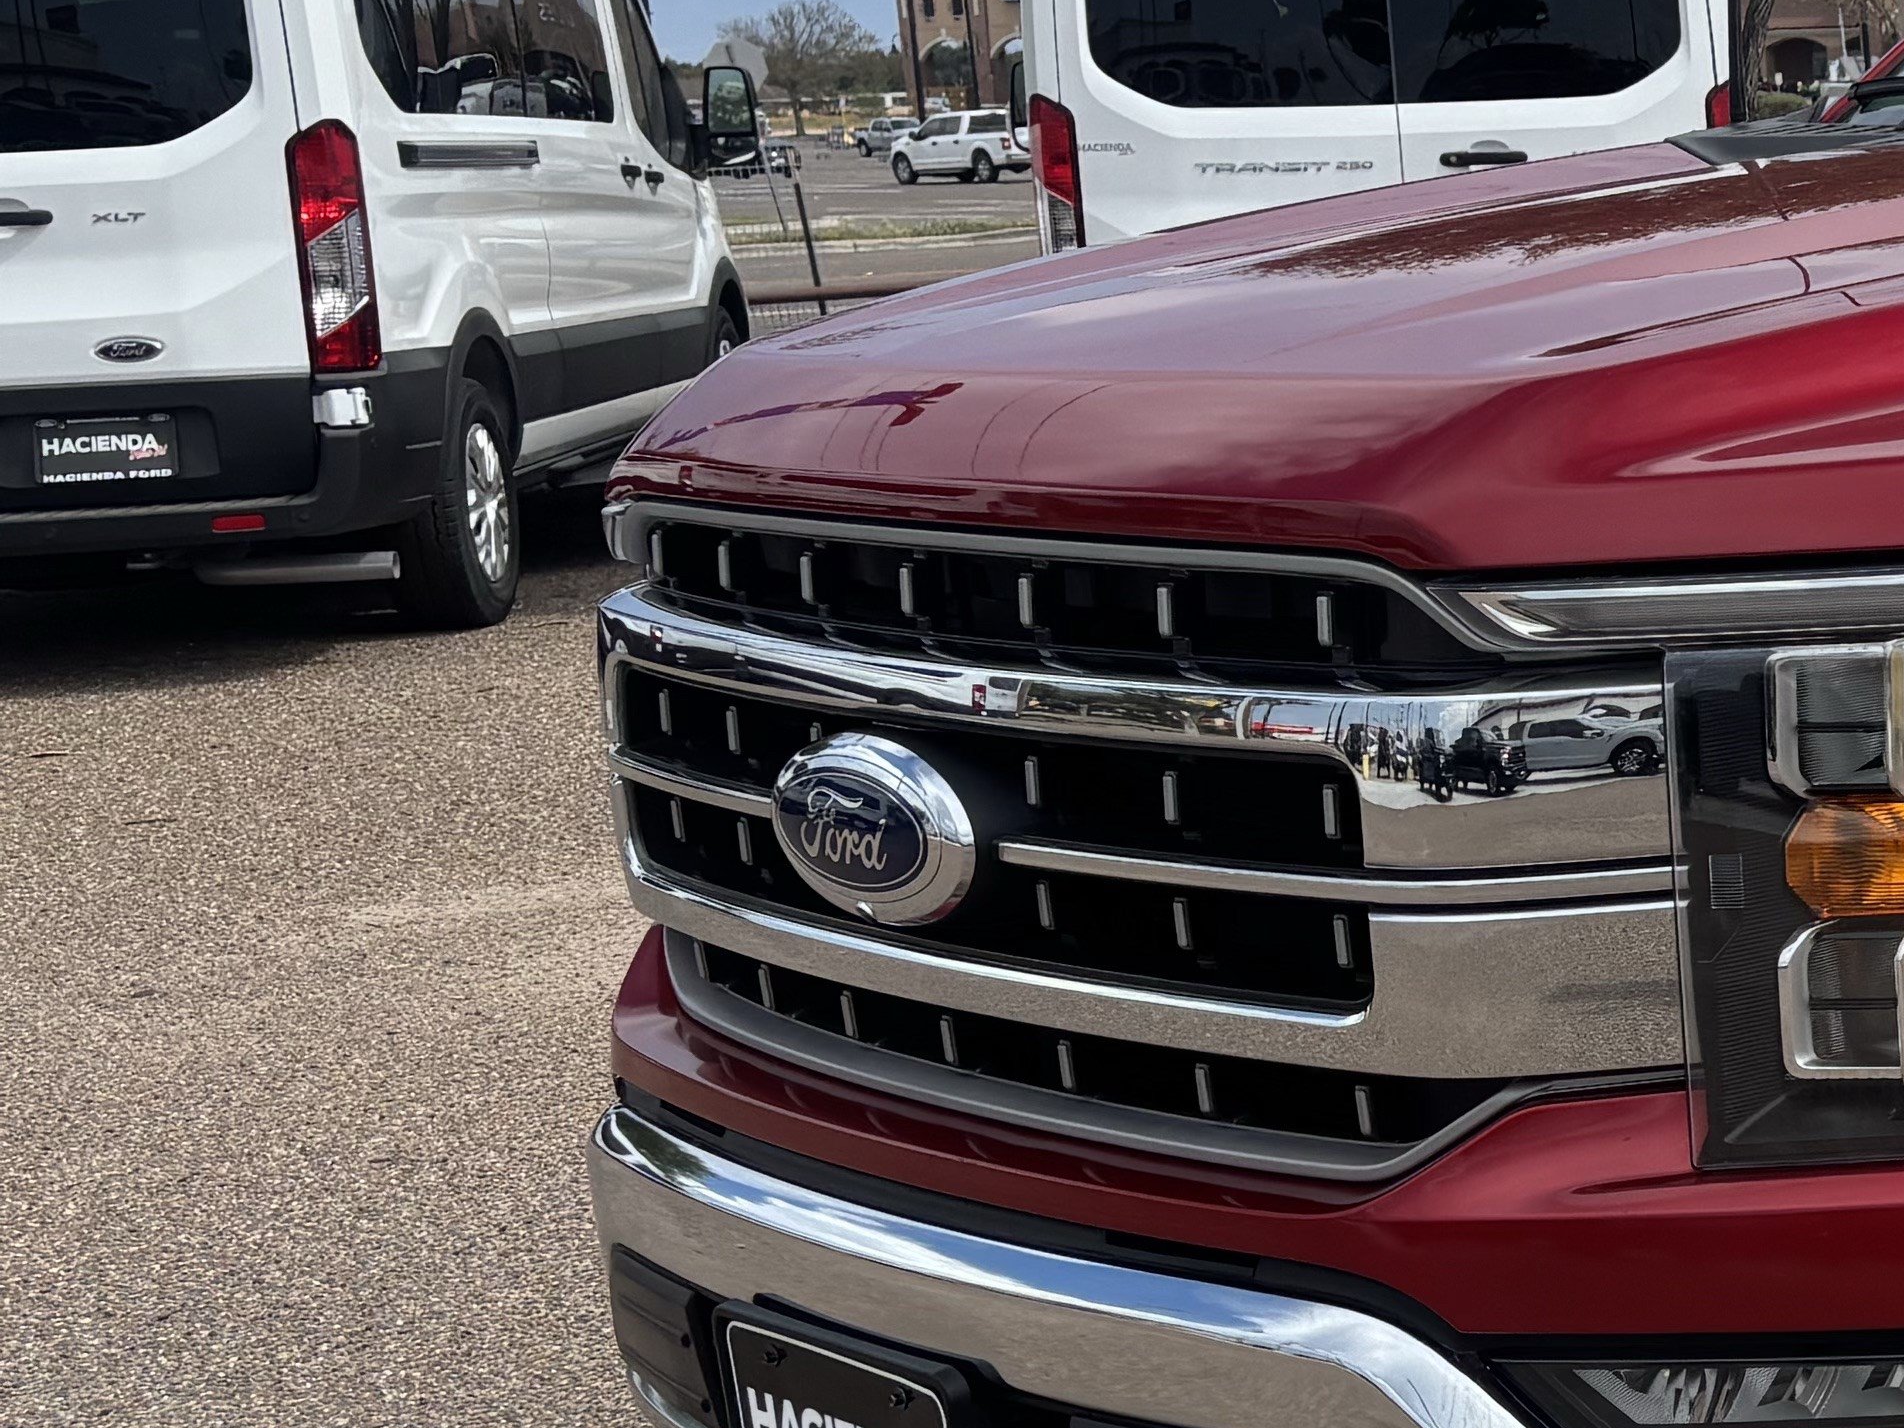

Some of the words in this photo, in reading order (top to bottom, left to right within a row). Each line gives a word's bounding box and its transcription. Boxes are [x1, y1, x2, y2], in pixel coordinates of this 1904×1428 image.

[1194, 161, 1330, 173] TRANSIT
[92, 212, 145, 224] XLT
[41, 433, 158, 457] HACIENDA
[42, 470, 125, 483] HACIENDA
[129, 468, 173, 479] FORD
[800, 786, 887, 870] Ford
